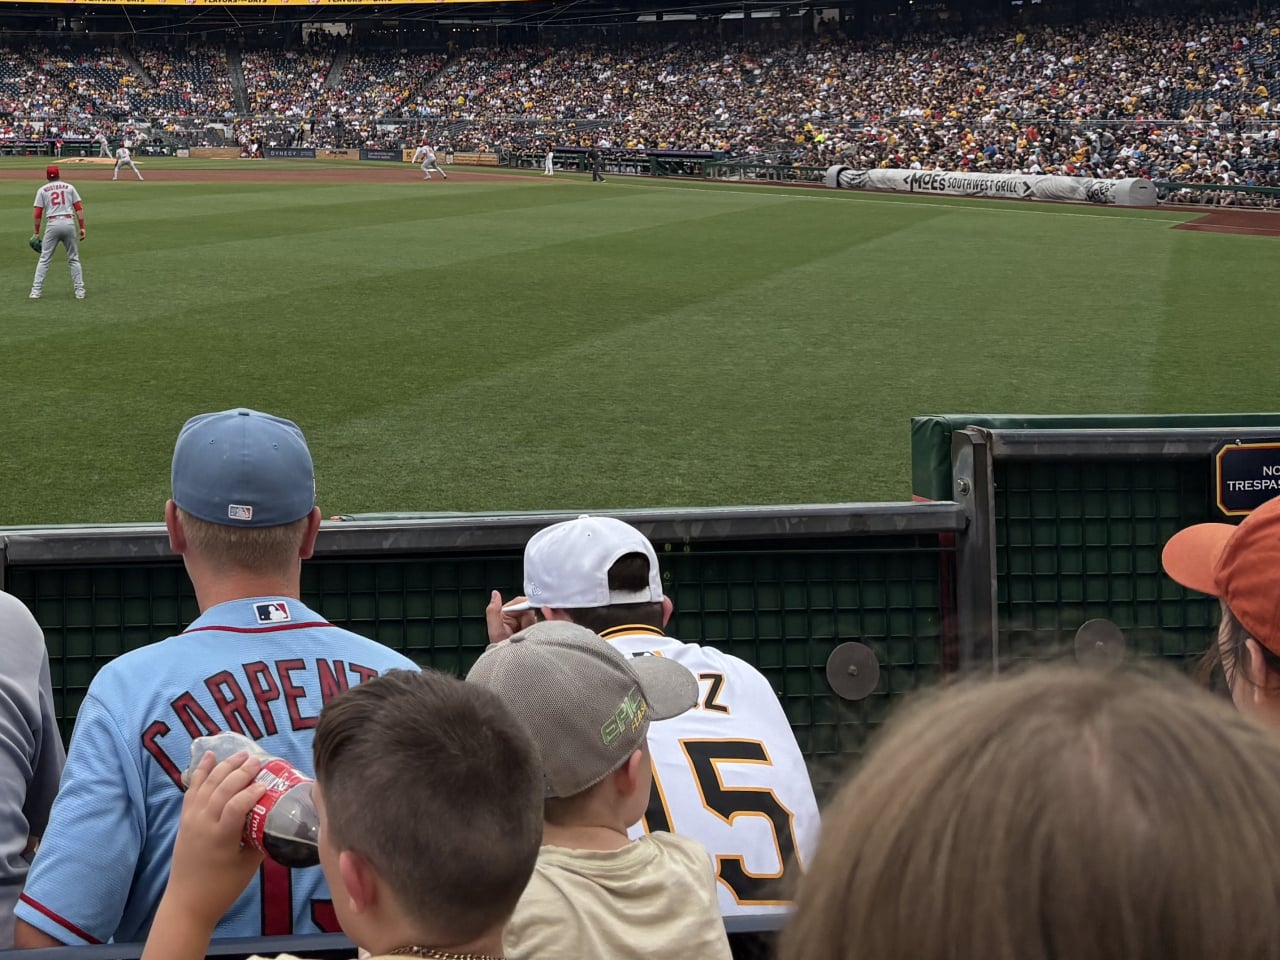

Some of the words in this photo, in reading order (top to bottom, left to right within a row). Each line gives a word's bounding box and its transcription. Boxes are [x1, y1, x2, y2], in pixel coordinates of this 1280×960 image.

[947, 177, 993, 191] SOUTHWEST
[995, 181, 1017, 193] GRILL
[51, 191, 66, 207] 21
[601, 686, 642, 746] EPIC
